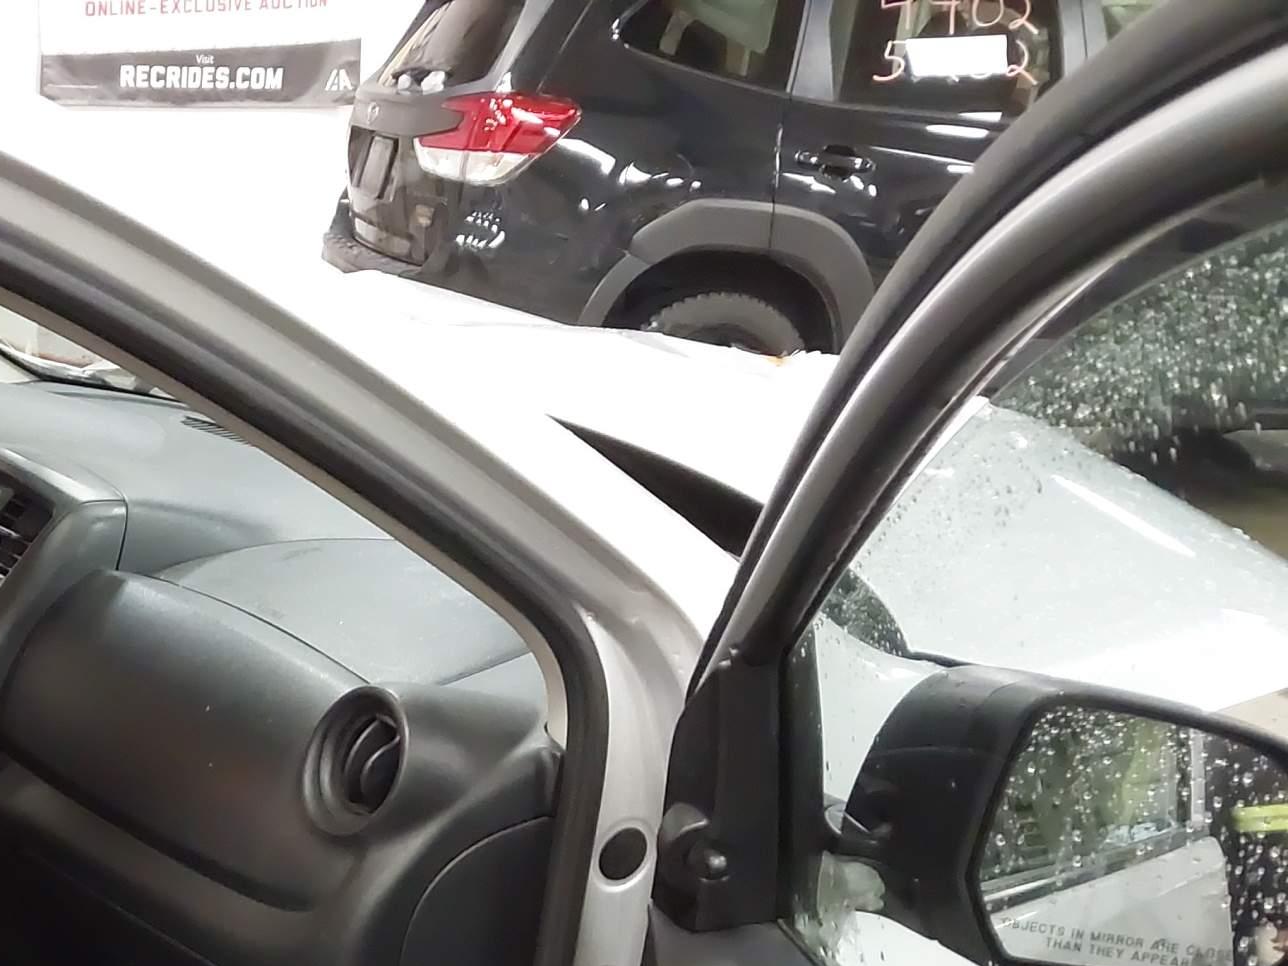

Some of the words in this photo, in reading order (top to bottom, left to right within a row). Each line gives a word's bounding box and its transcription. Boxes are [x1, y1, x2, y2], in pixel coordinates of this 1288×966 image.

[85, 0, 253, 17] ONLINE-EXCLUSIVE
[195, 54, 214, 65] Visit
[119, 64, 284, 90] RECRIDES.COM
[1001, 917, 1066, 937] OBJECTS
[1070, 927, 1085, 940] IN
[1090, 931, 1144, 948] MIRROR
[1150, 938, 1179, 954] ARE
[1045, 937, 1083, 953] THAN
[1089, 943, 1124, 959] THEY
